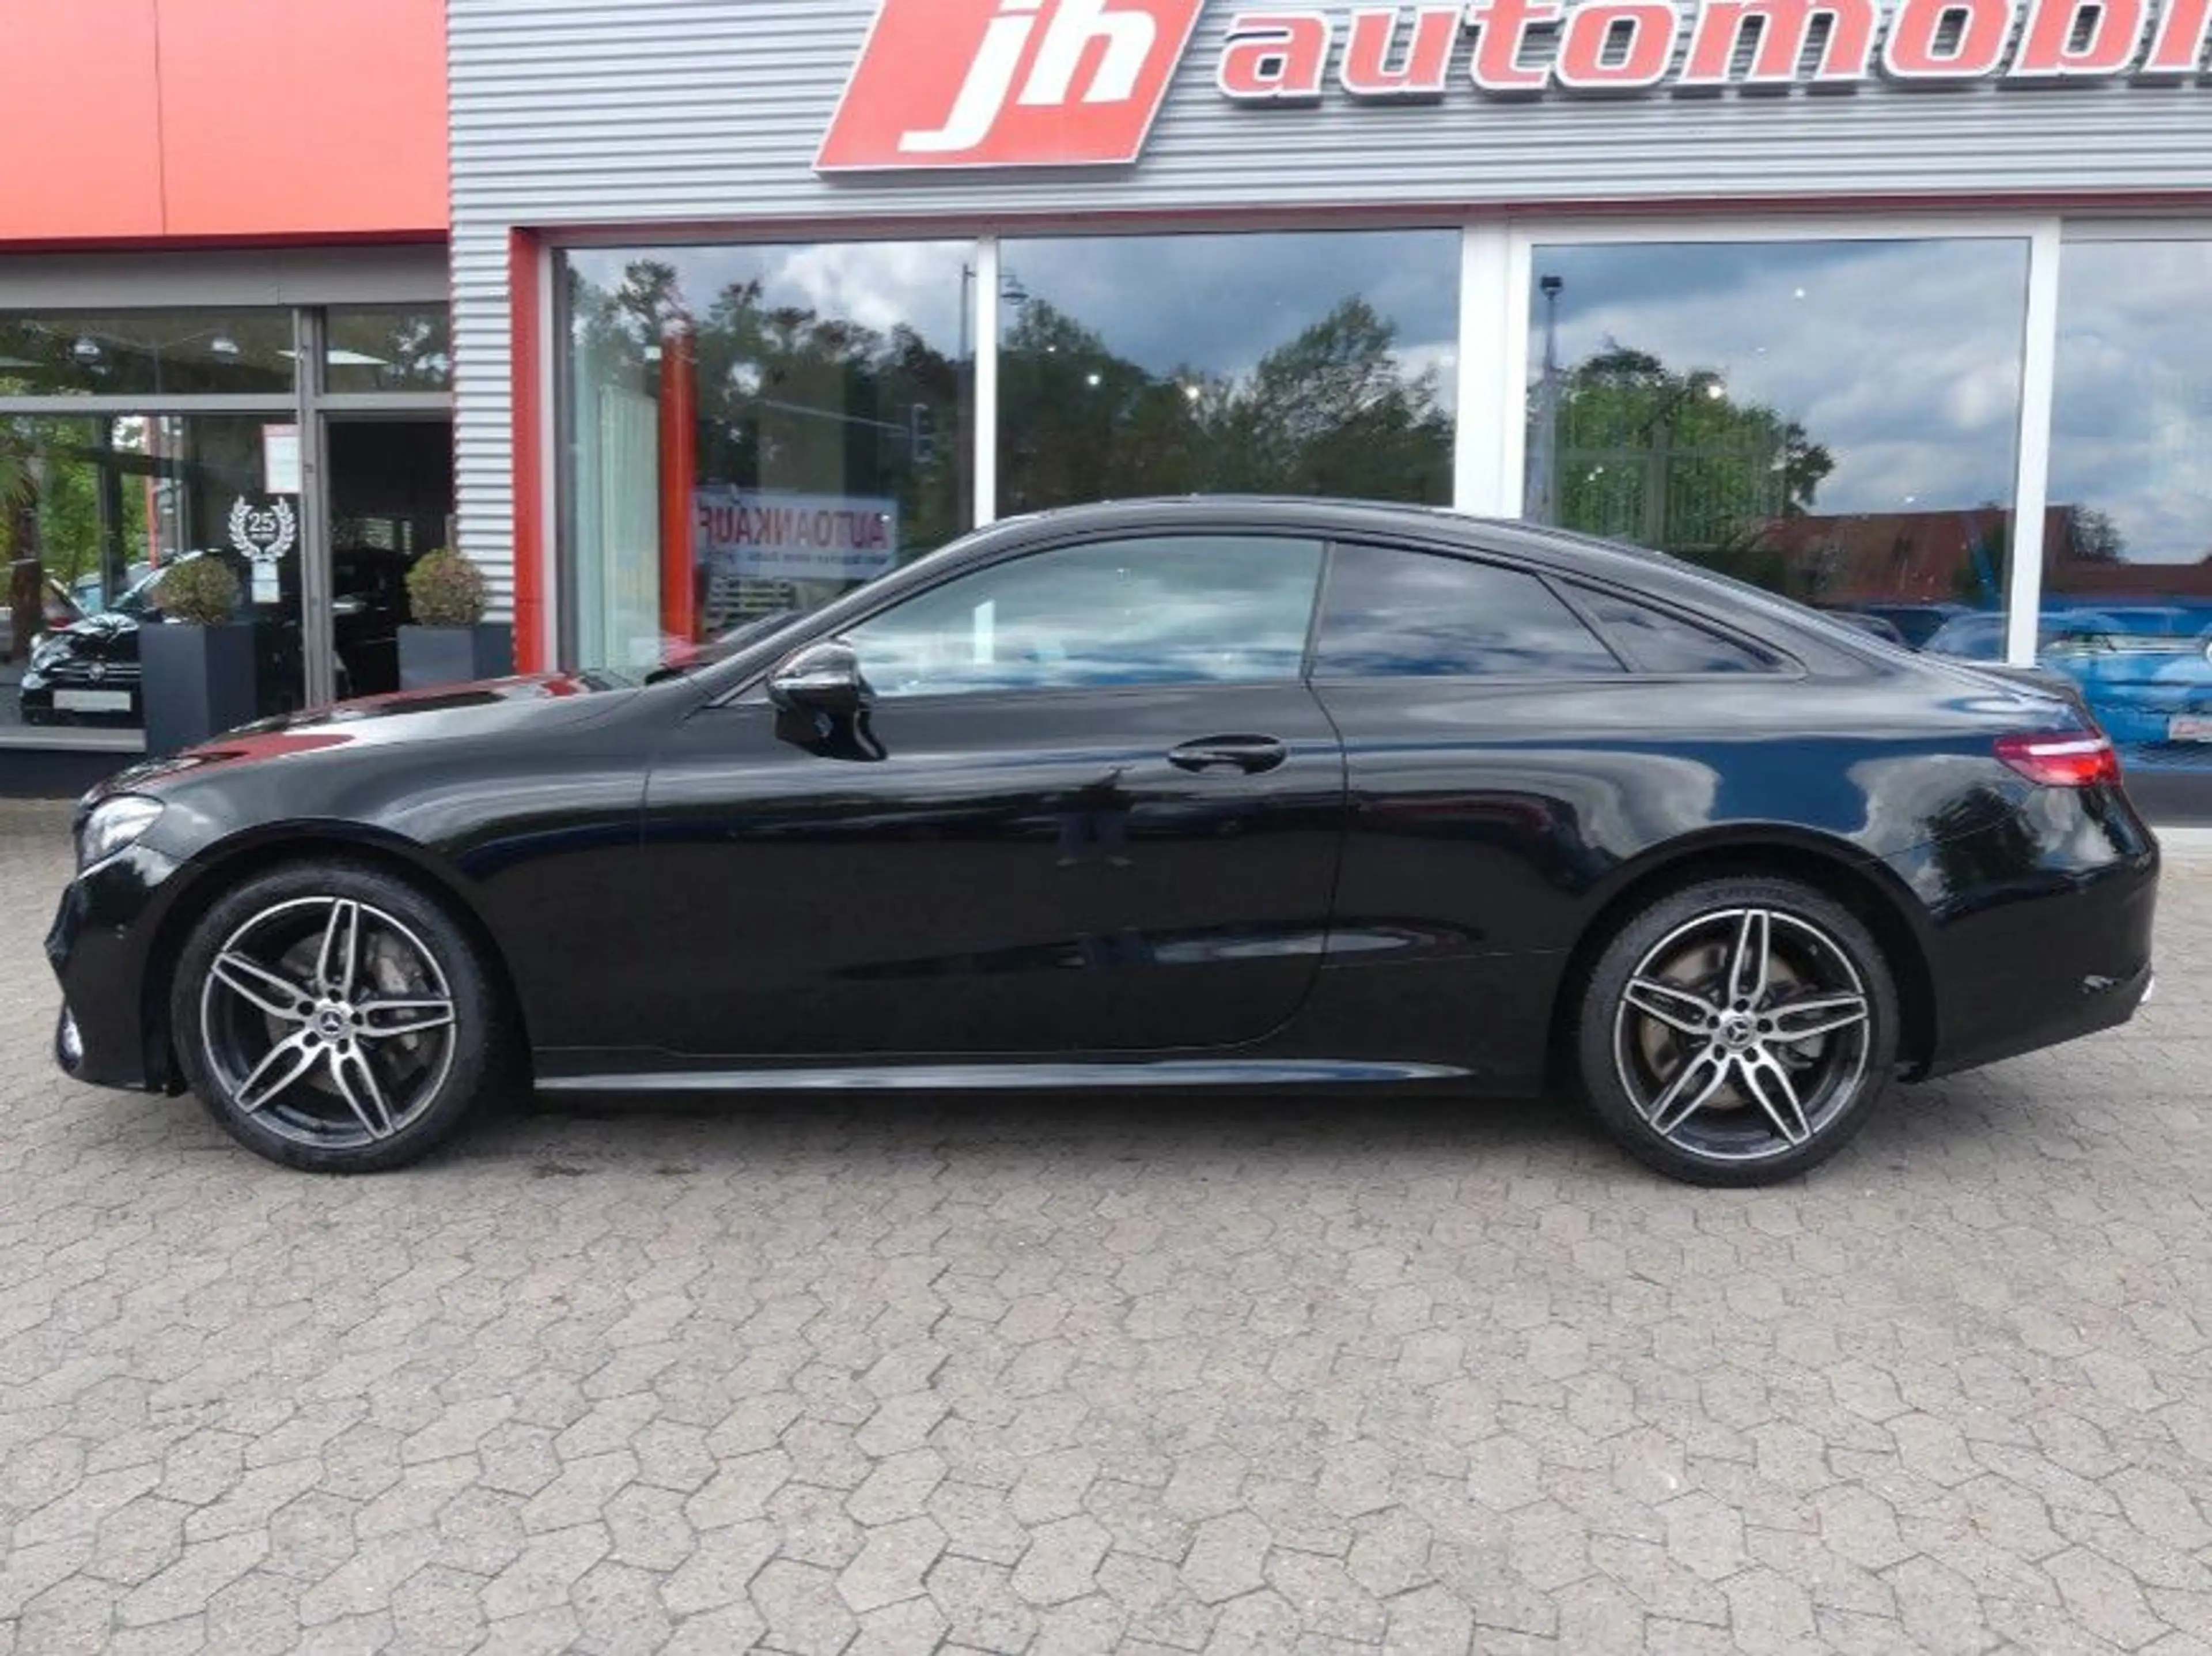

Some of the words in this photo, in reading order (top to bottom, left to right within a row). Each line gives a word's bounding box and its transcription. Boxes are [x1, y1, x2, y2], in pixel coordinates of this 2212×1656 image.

[896, 0, 1156, 152] jh
[1217, 0, 2212, 98] automobi
[249, 512, 276, 531] 25
